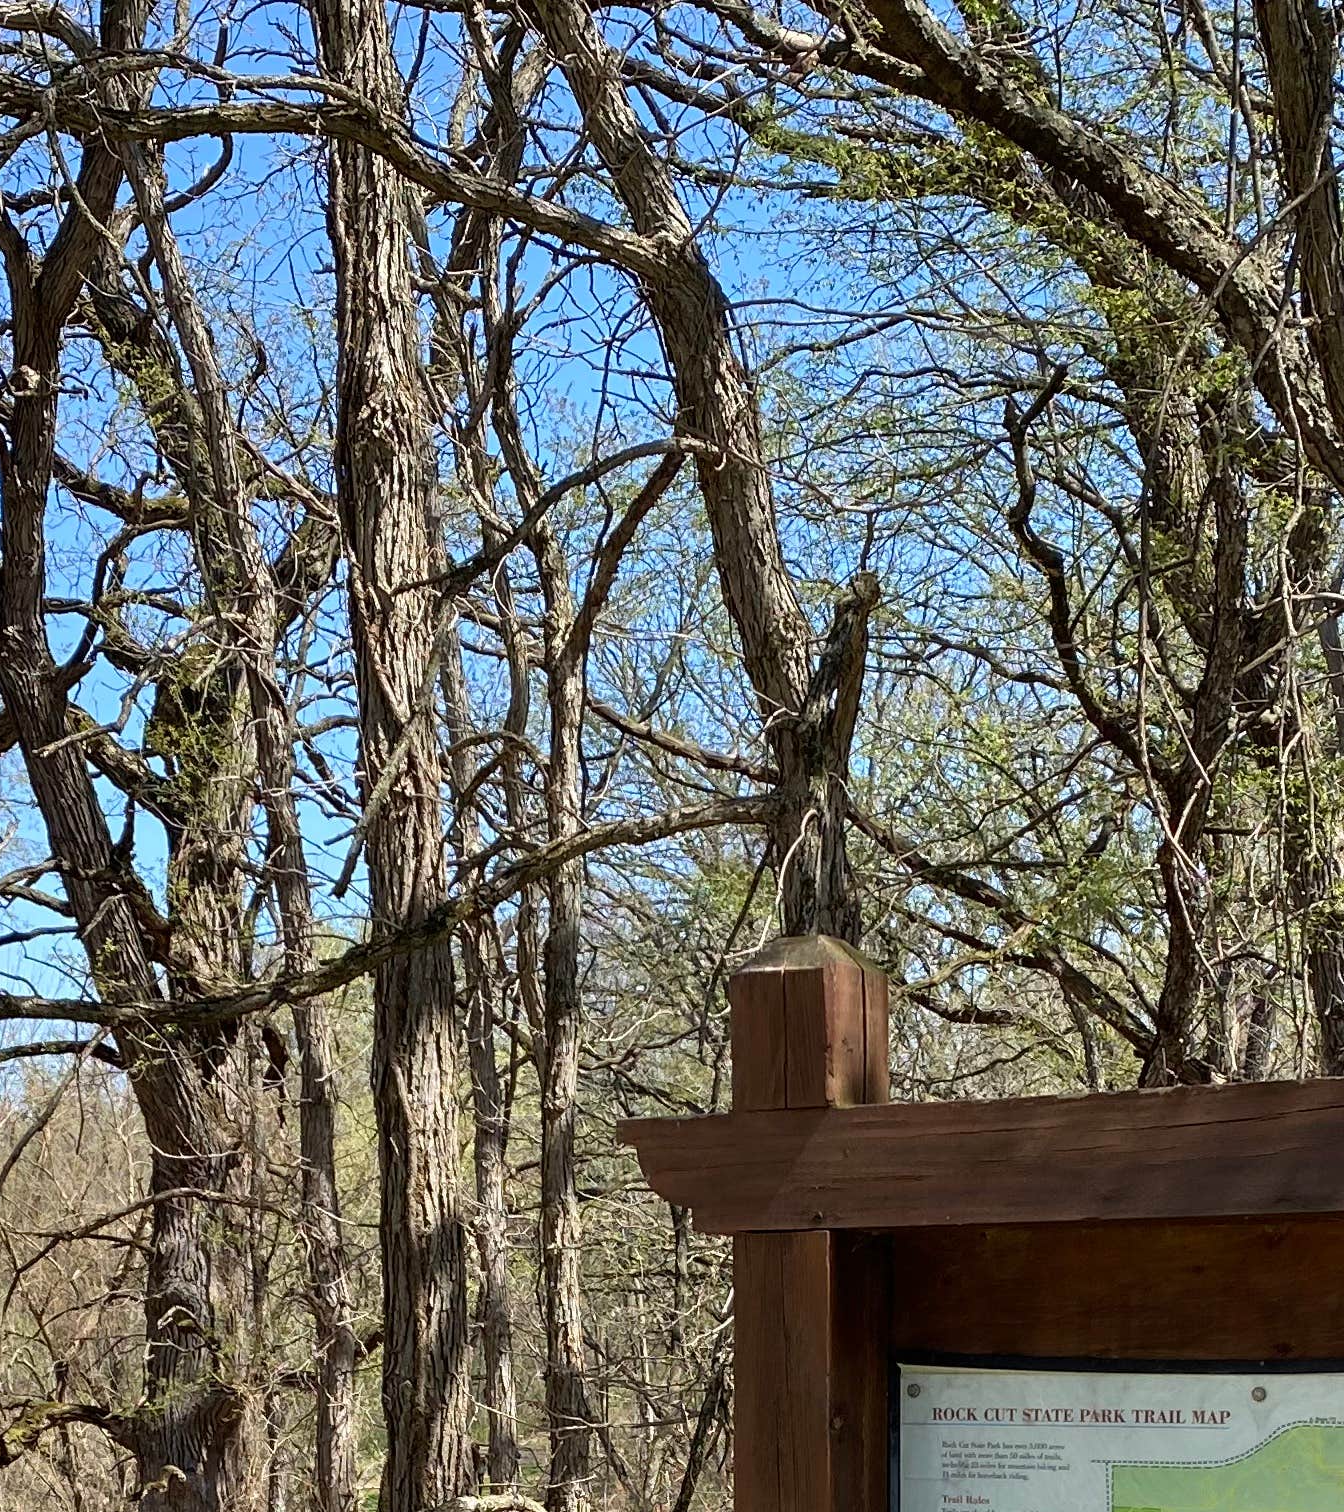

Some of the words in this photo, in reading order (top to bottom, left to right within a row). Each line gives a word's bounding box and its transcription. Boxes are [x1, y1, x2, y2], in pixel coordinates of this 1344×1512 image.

[932, 1408, 977, 1420] ROCK
[984, 1408, 1017, 1421] CUT
[1022, 1409, 1074, 1422] STATE
[1080, 1409, 1126, 1423] PARK
[1131, 1410, 1186, 1423] TRAIL
[1192, 1410, 1231, 1424] MAP
